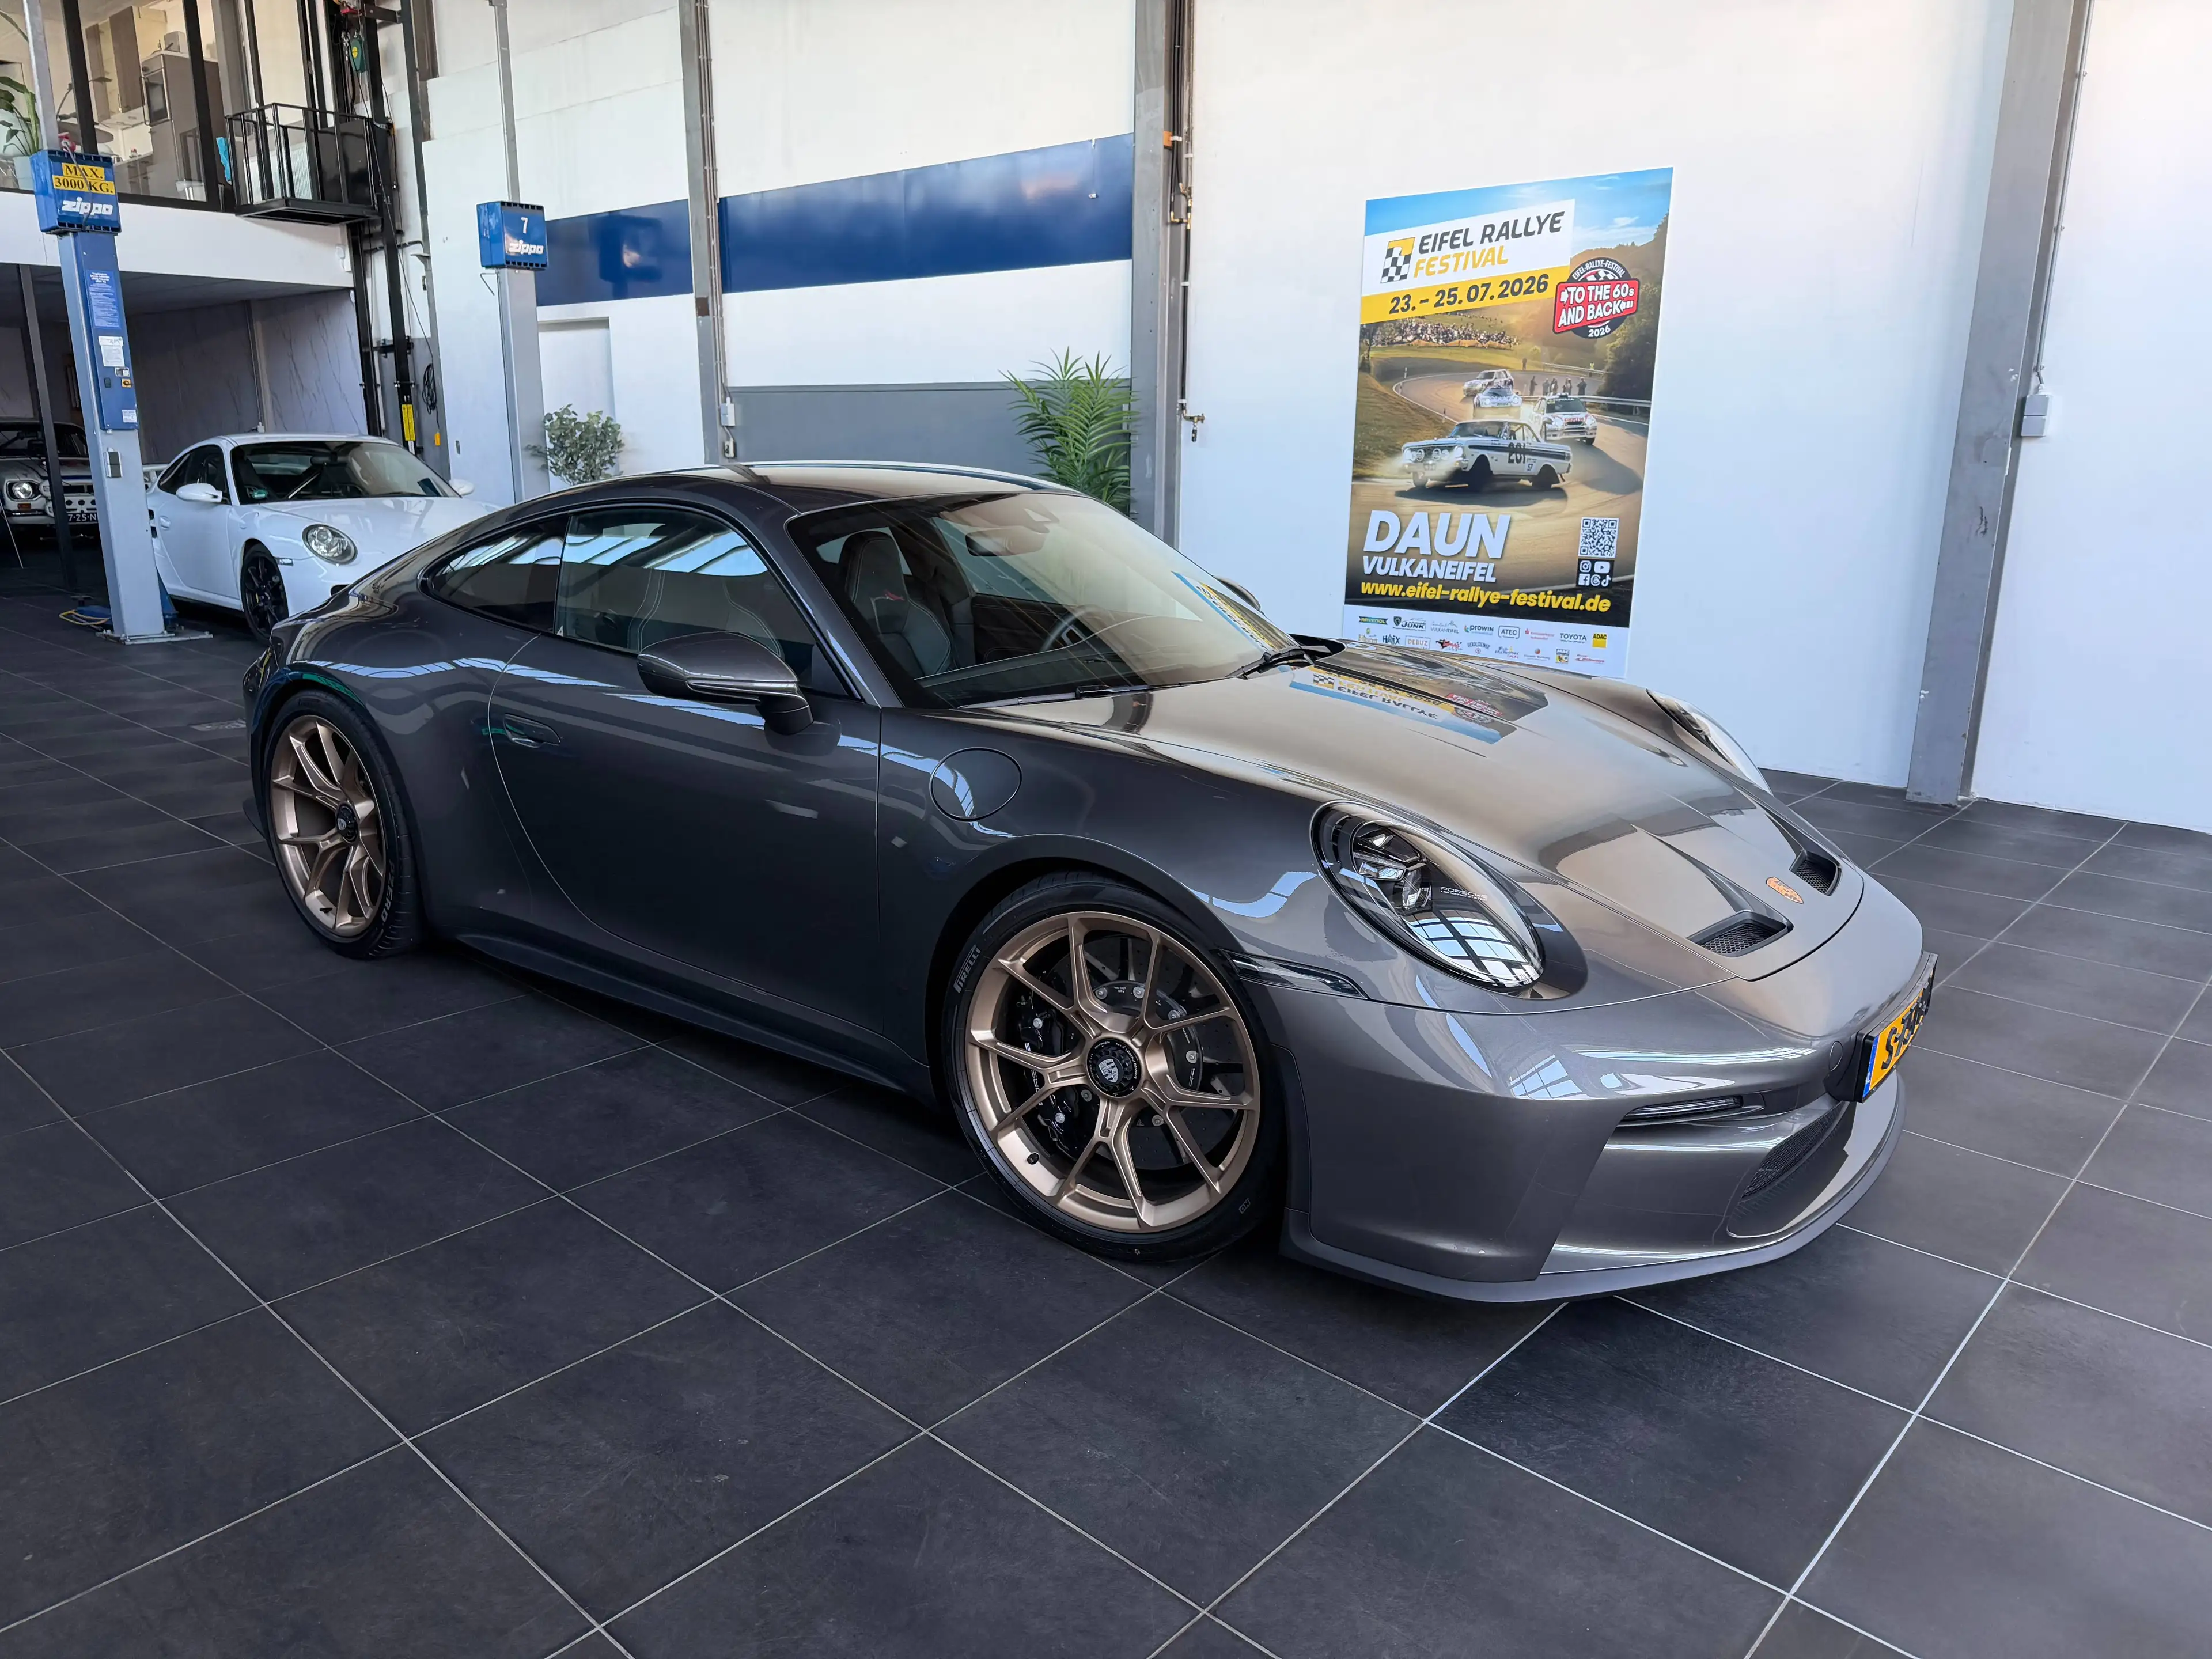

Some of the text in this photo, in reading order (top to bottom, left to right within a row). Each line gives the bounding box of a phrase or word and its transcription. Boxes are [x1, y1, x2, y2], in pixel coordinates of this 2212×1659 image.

[65, 165, 103, 179] MAX.
[55, 177, 113, 194] 3000 KG.
[62, 196, 113, 216] zippo
[521, 217, 528, 234] 7
[1418, 211, 1565, 255] EIFEL RALLYE
[509, 239, 544, 255] zippo
[1413, 245, 1509, 278] FESTIVAL
[1567, 283, 1634, 305] TO THE 60s
[1389, 294, 1416, 315] 23.
[1558, 299, 1620, 327] AND BACK
[1588, 325, 1611, 338] 2026
[1363, 510, 1511, 559] DAUN
[1362, 555, 1497, 583] VULKANEIFEL
[1361, 581, 1611, 612] www.eifel-rallye-festival.de
[1501, 628, 1517, 637] ATEC
[1560, 633, 1587, 641] TOYOTA
[1441, 887, 1488, 899] PORSCHE
[953, 944, 981, 994] PIRELLI
